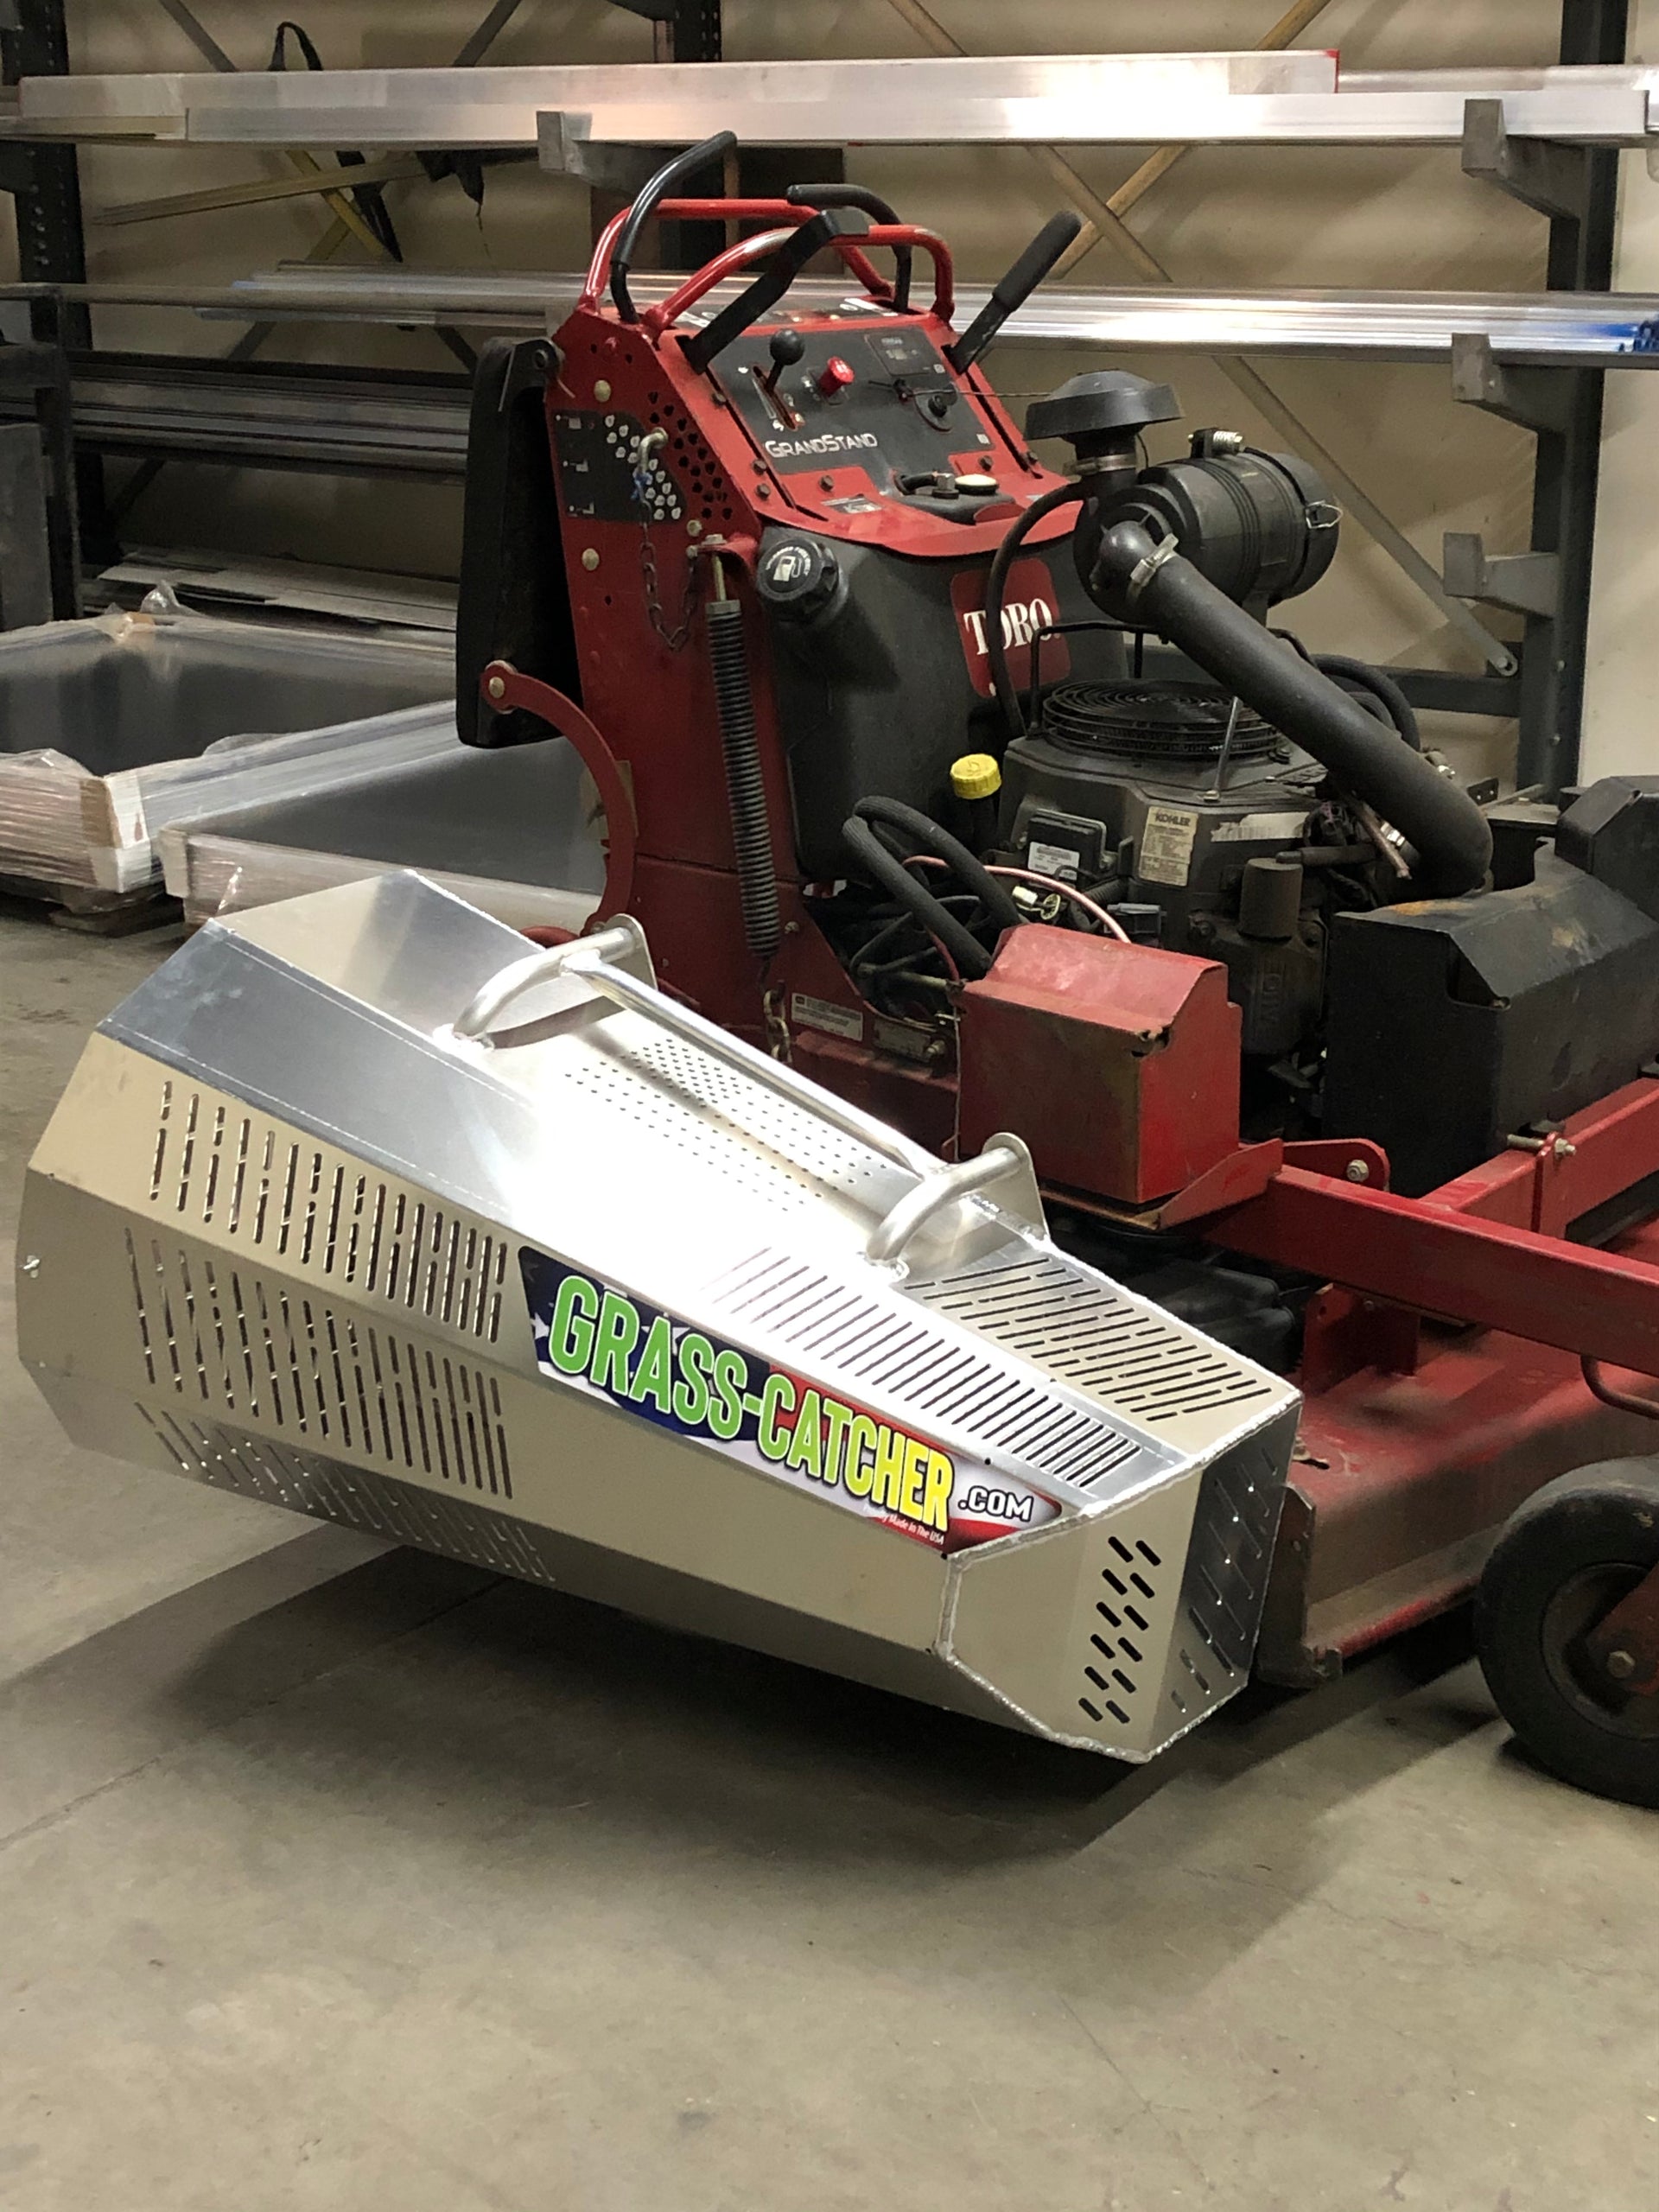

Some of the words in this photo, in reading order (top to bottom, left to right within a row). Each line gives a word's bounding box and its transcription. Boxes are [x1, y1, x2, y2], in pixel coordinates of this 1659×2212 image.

[1154, 813, 1192, 827] KOHLER
[548, 1274, 956, 1531] GRASS-CATCHER
[929, 1531, 945, 1545] USA
